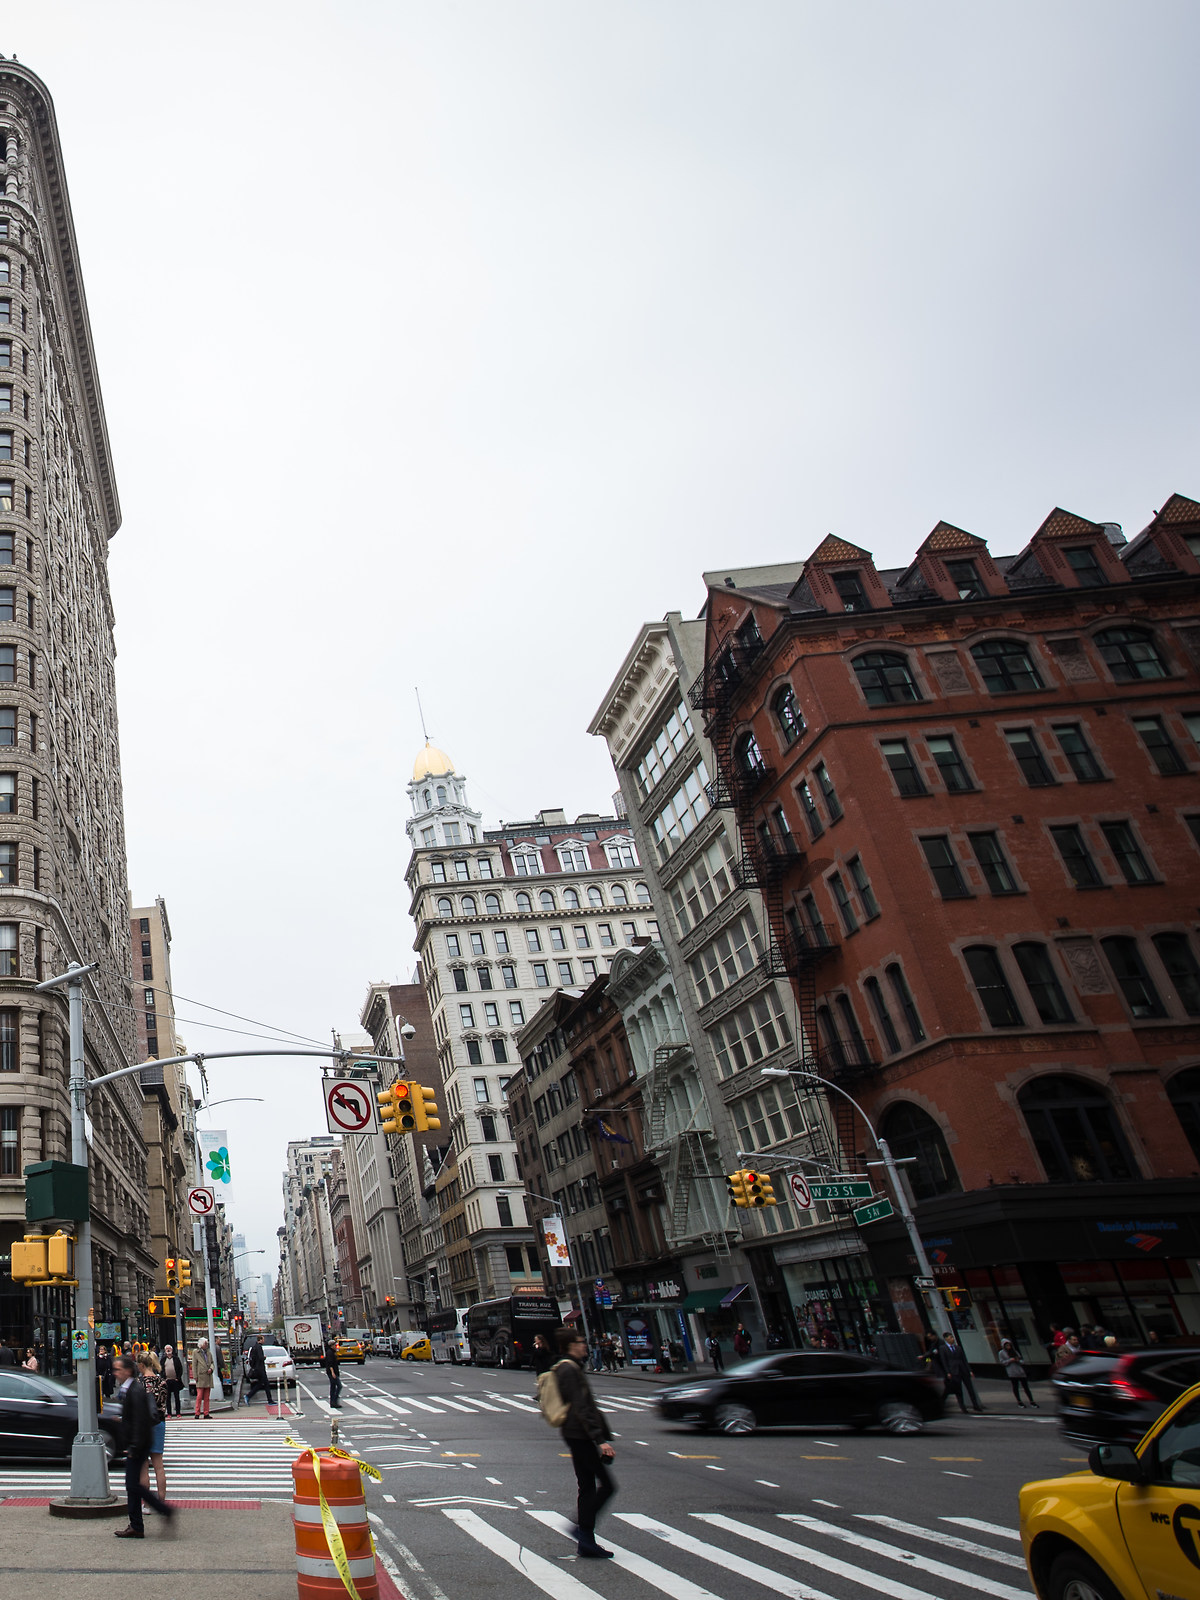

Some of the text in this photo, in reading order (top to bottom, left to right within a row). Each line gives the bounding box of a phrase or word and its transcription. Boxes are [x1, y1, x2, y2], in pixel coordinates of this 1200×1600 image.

[811, 1185, 854, 1197] W 23 St
[867, 1209, 872, 1219] 5
[1150, 1512, 1171, 1525] NYC
